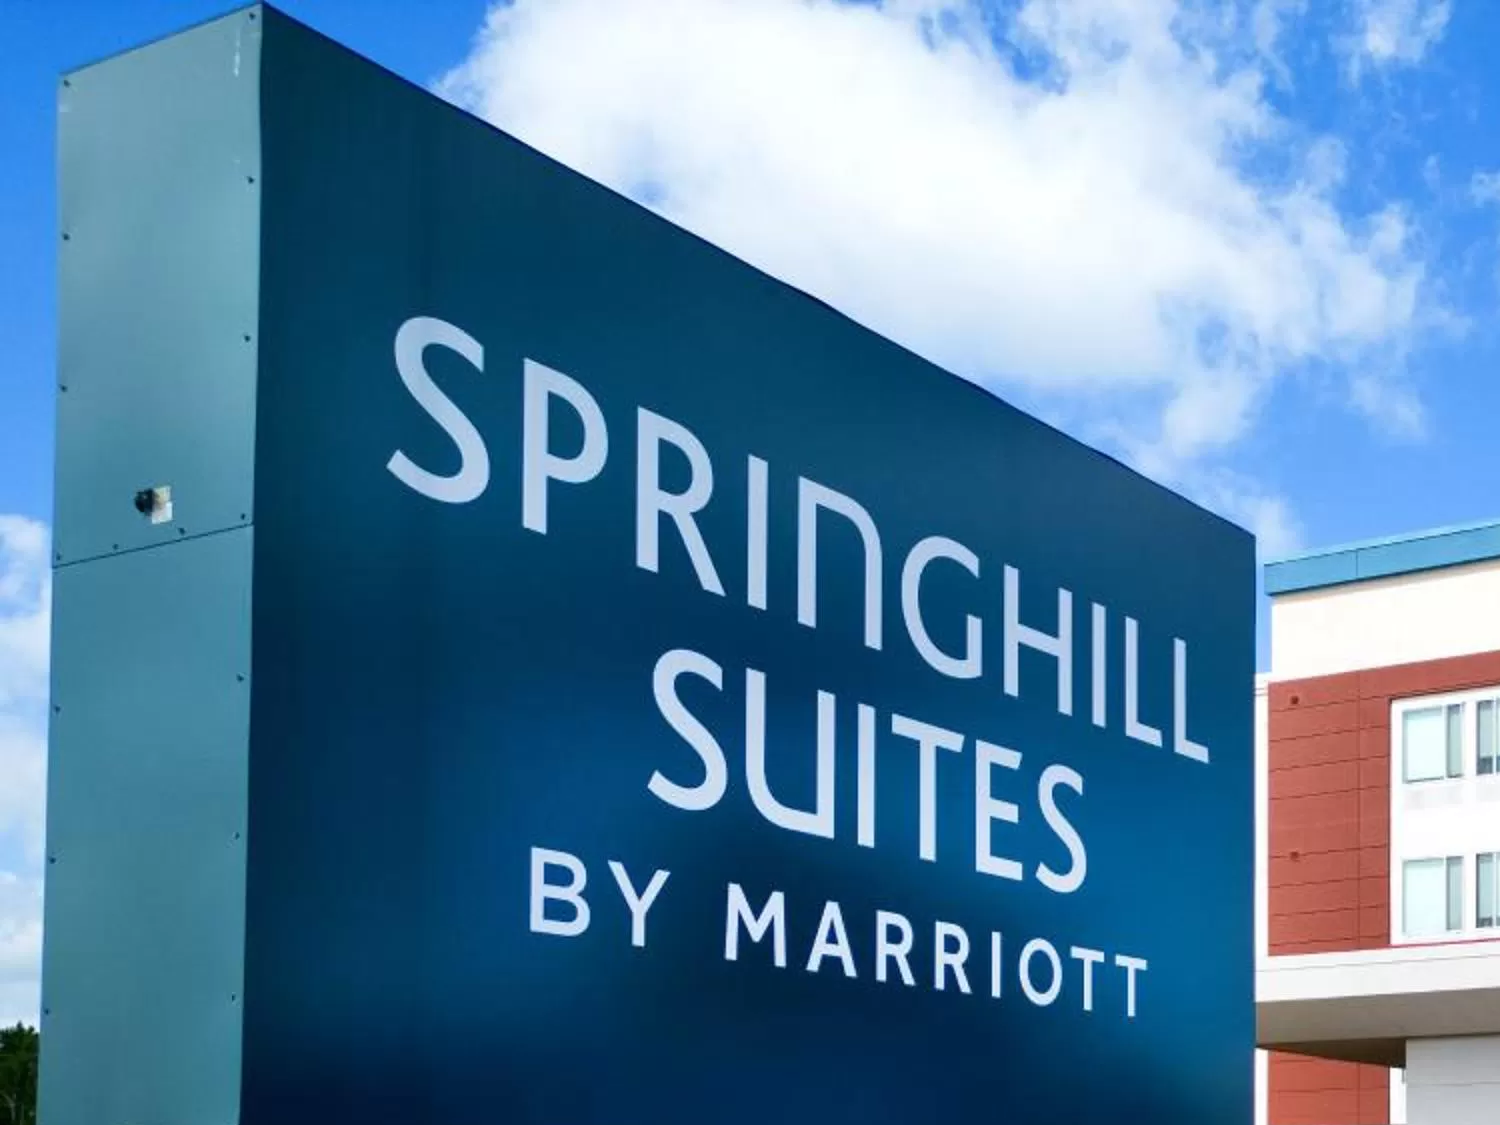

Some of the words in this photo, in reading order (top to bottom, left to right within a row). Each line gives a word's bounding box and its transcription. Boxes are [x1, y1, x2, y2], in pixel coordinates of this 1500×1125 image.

[386, 315, 1210, 764] SPRINGHILL
[647, 648, 1088, 894] SUITES
[529, 846, 671, 947] BY
[724, 882, 1148, 1018] MARRIOTT
